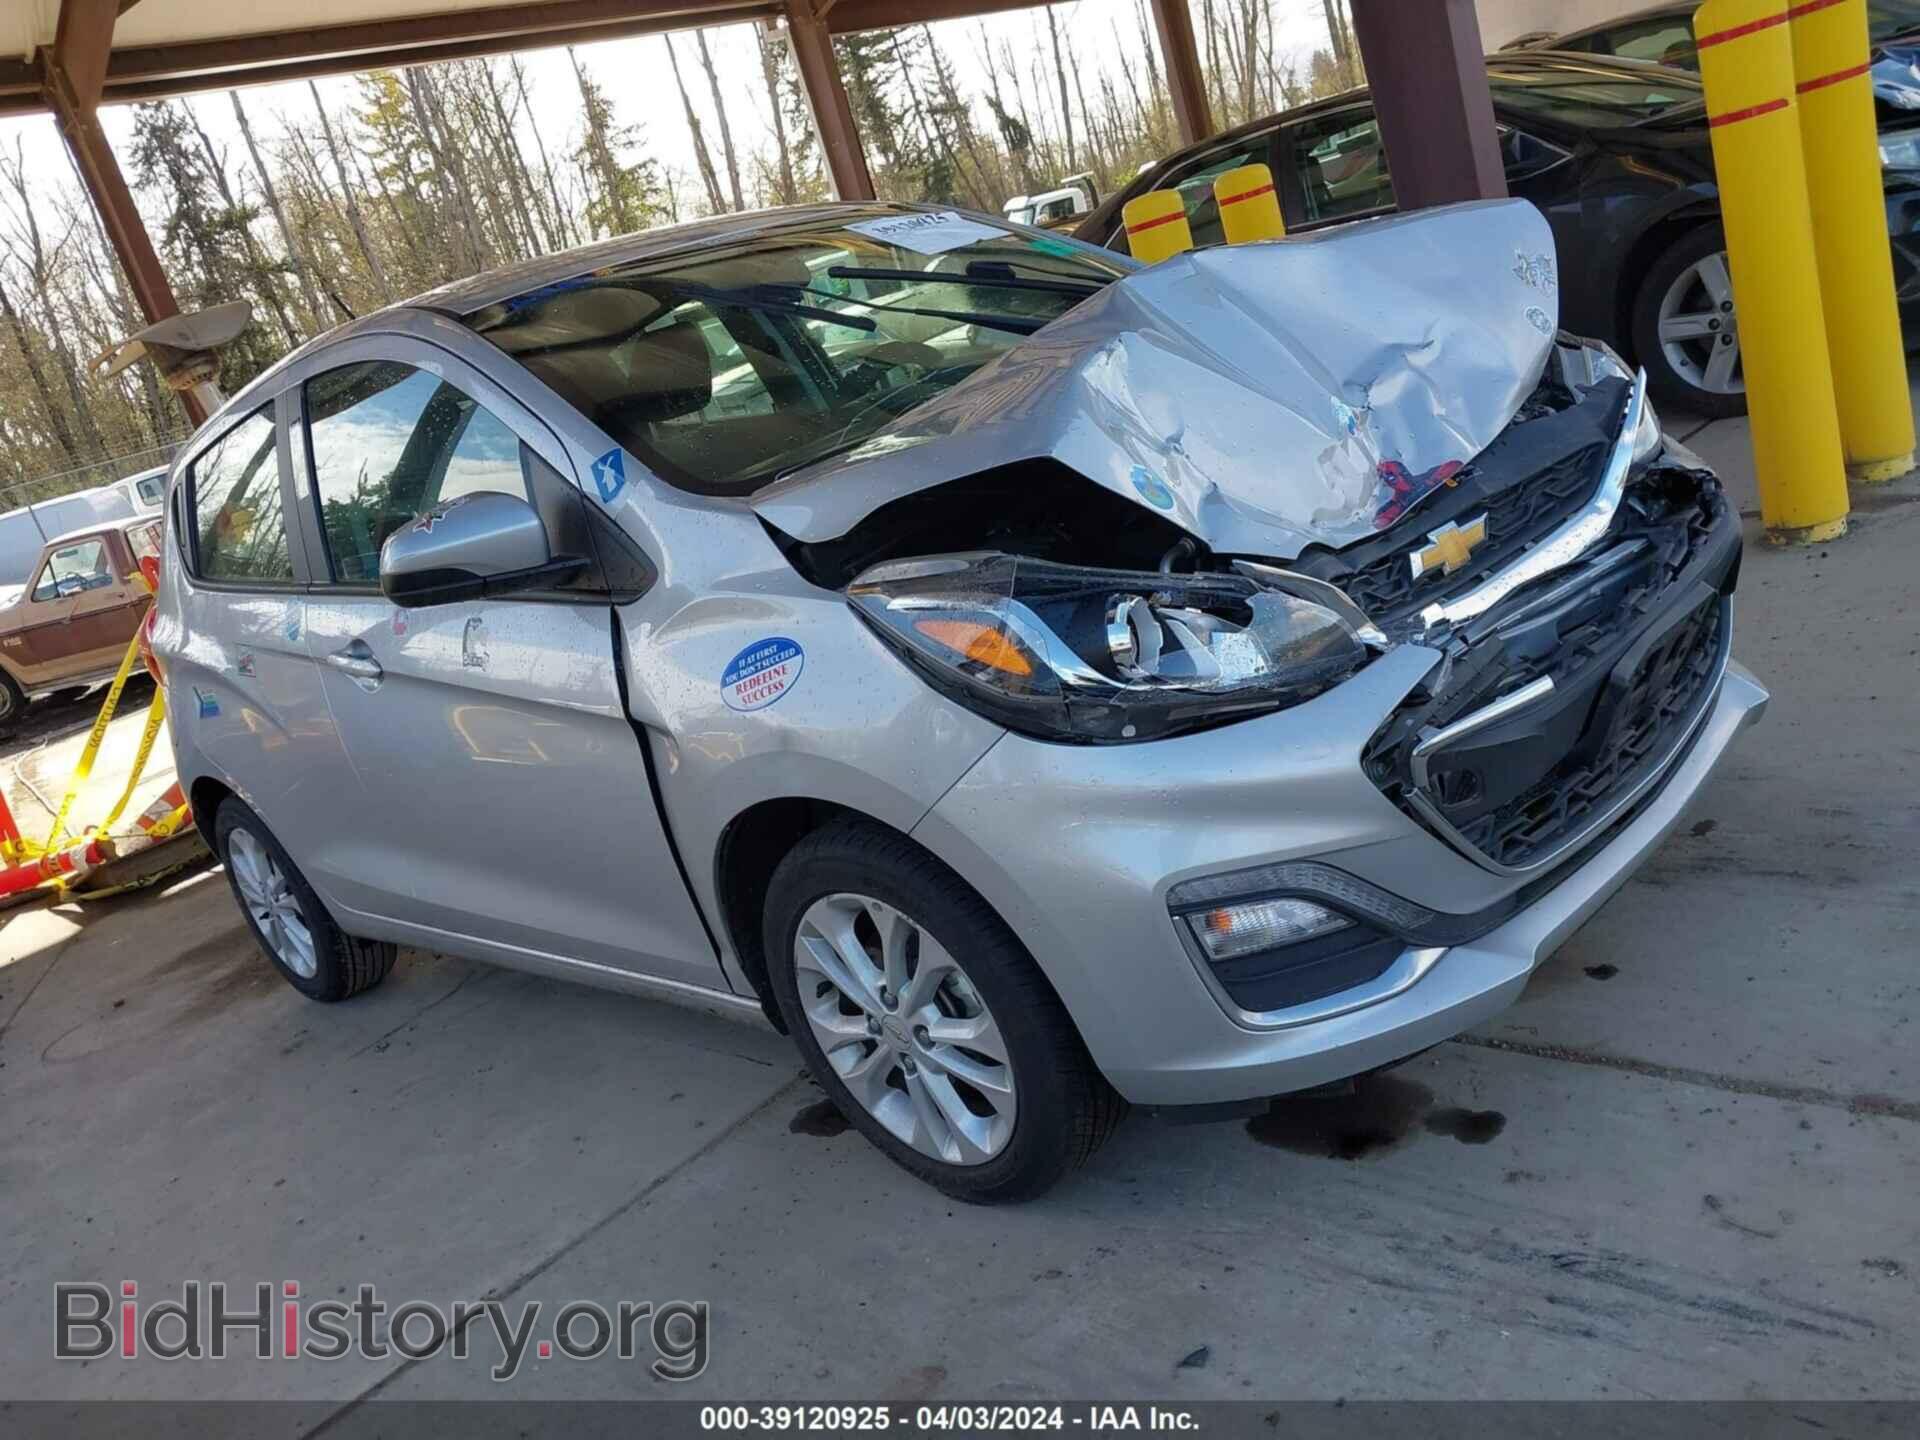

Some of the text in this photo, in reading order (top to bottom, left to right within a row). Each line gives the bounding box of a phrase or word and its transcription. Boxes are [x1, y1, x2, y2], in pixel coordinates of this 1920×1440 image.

[756, 645, 777, 660] FIRST
[762, 647, 796, 666] SUCCEED
[736, 664, 786, 696] REDEFINE
[742, 680, 784, 704] SUCCESS
